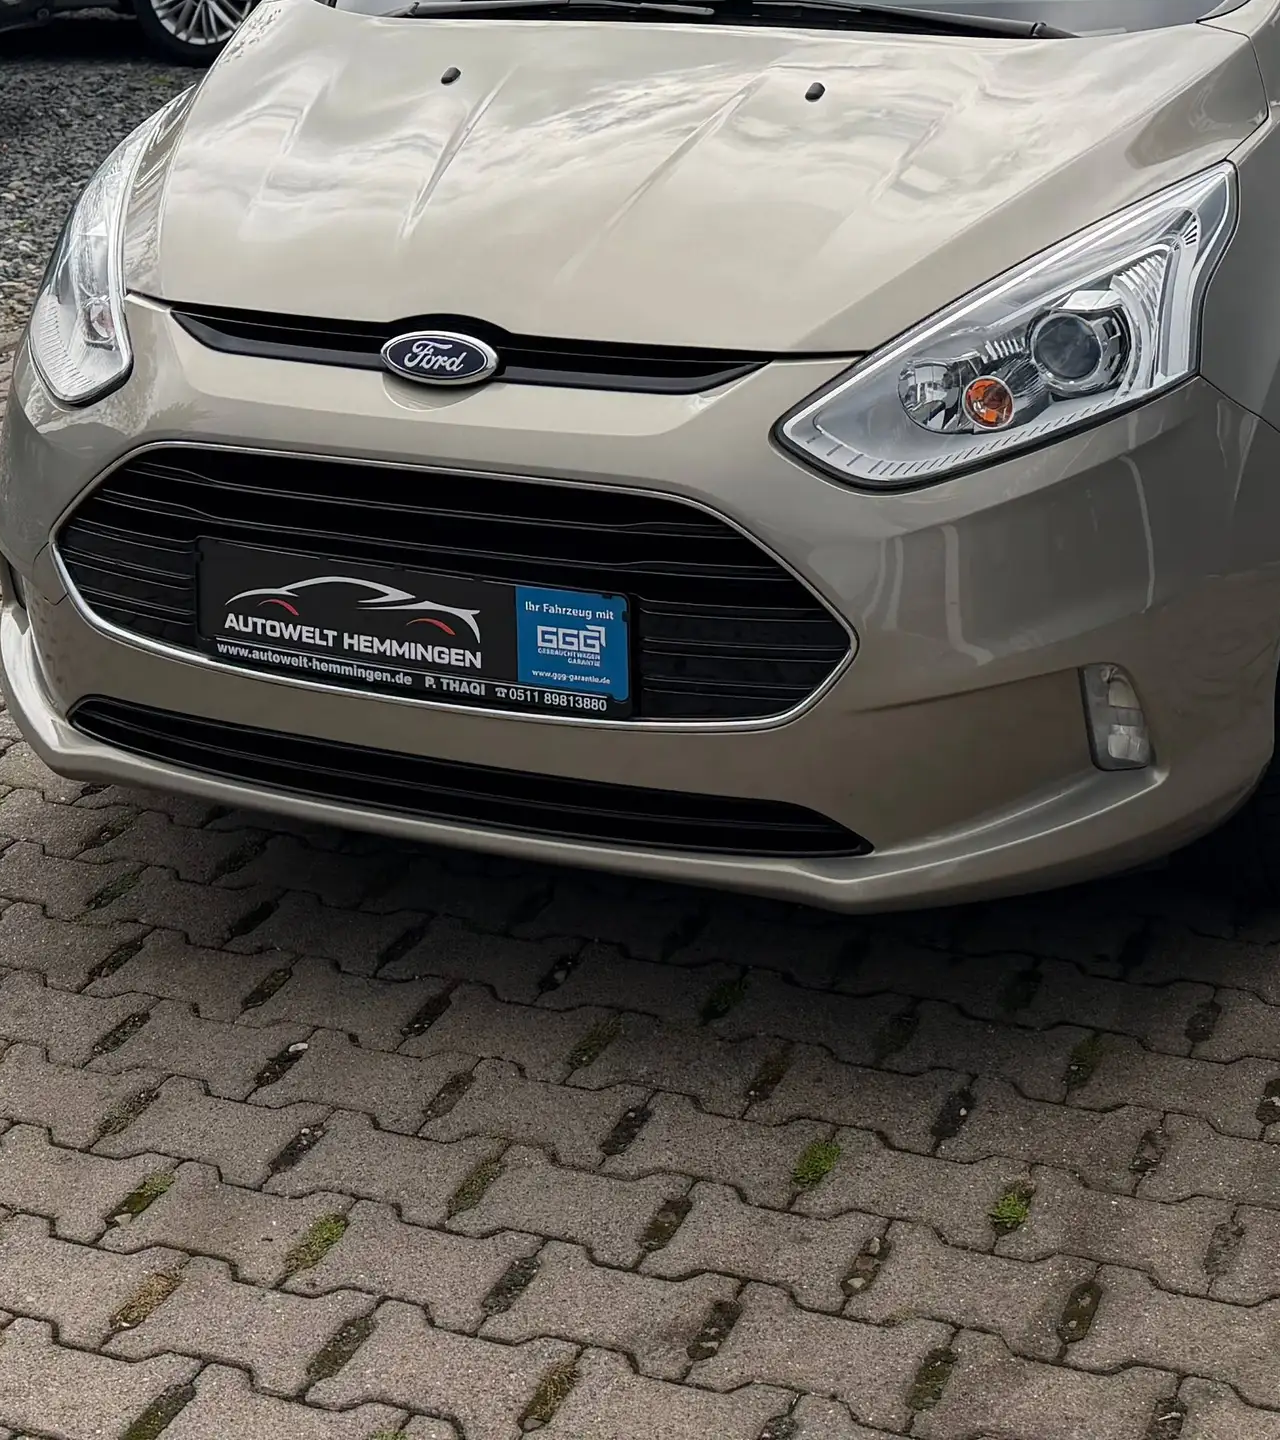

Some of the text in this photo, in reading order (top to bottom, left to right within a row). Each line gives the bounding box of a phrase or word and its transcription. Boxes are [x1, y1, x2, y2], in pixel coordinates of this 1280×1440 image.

[404, 340, 467, 372] Ford
[525, 601, 614, 621] Ihr Fahrzeug mit
[224, 612, 482, 669] AUTOWELT HEMMINGEN
[537, 624, 606, 653] GGG
[217, 643, 608, 712] www.autowelt-hemmingen.de P. THAQI 0511 89813880
